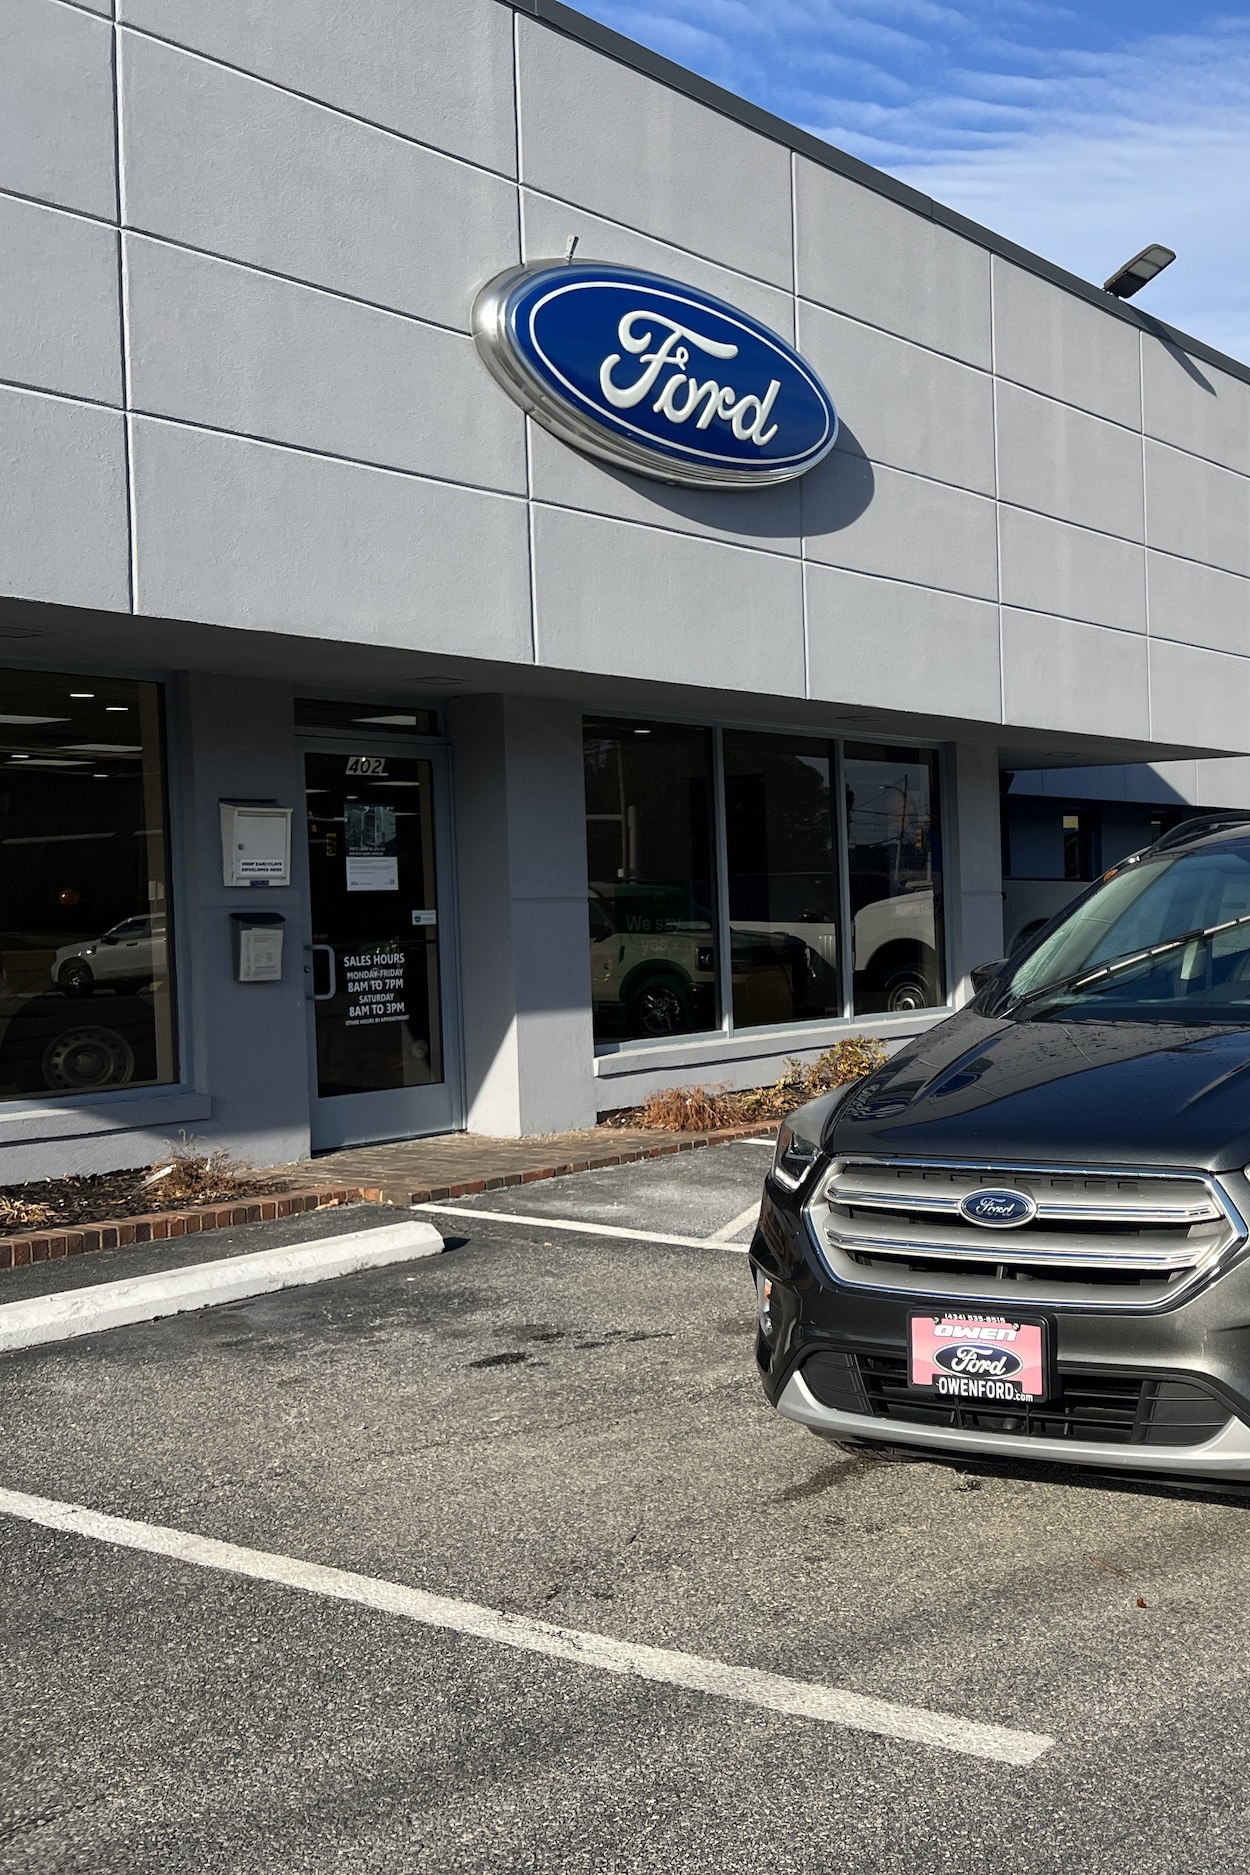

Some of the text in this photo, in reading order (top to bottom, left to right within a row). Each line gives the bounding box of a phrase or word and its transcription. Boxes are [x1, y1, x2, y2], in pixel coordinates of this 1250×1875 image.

[600, 310, 781, 446] Ford
[348, 758, 382, 774] 402
[344, 953, 405, 967] SALES HOURS
[346, 968, 404, 980] MONDAY-FRIDAY
[348, 978, 404, 993] 8AM TO 7PM
[359, 993, 394, 1004] SATURDAY
[349, 1002, 405, 1017] 8AM TO 3PM
[975, 1197, 1016, 1216] Ford
[933, 1324, 1018, 1342] OWEN
[951, 1346, 1008, 1376] Ford
